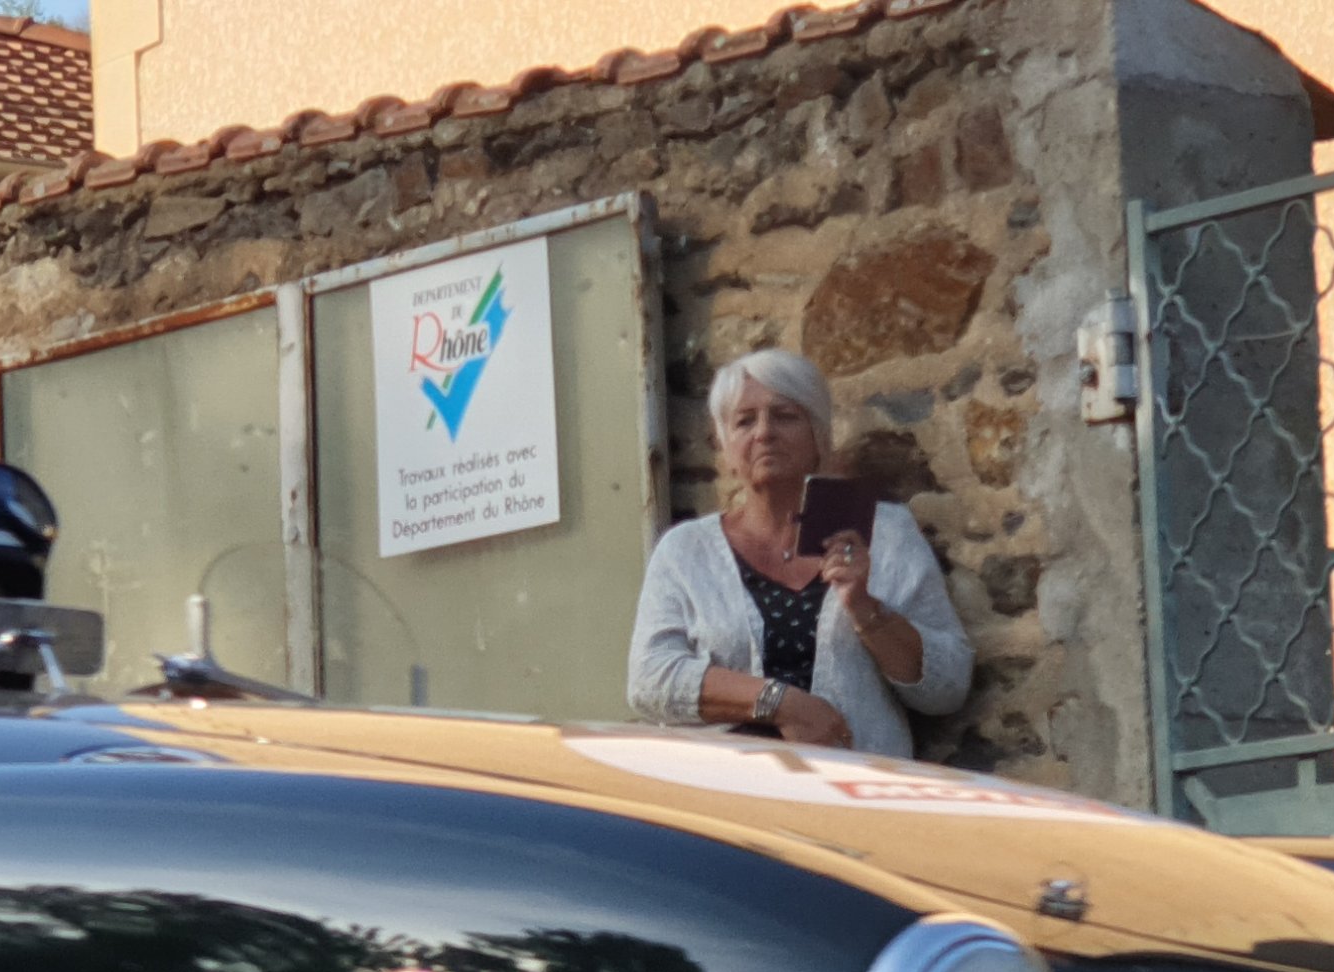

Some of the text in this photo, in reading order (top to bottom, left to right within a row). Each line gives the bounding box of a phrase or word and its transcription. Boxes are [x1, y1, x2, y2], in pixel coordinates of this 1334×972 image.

[410, 311, 487, 372] Rhône
[398, 445, 537, 487] Travaux réalisés avec
[405, 470, 526, 512] la participation du
[392, 495, 545, 540] Département du Rhône
